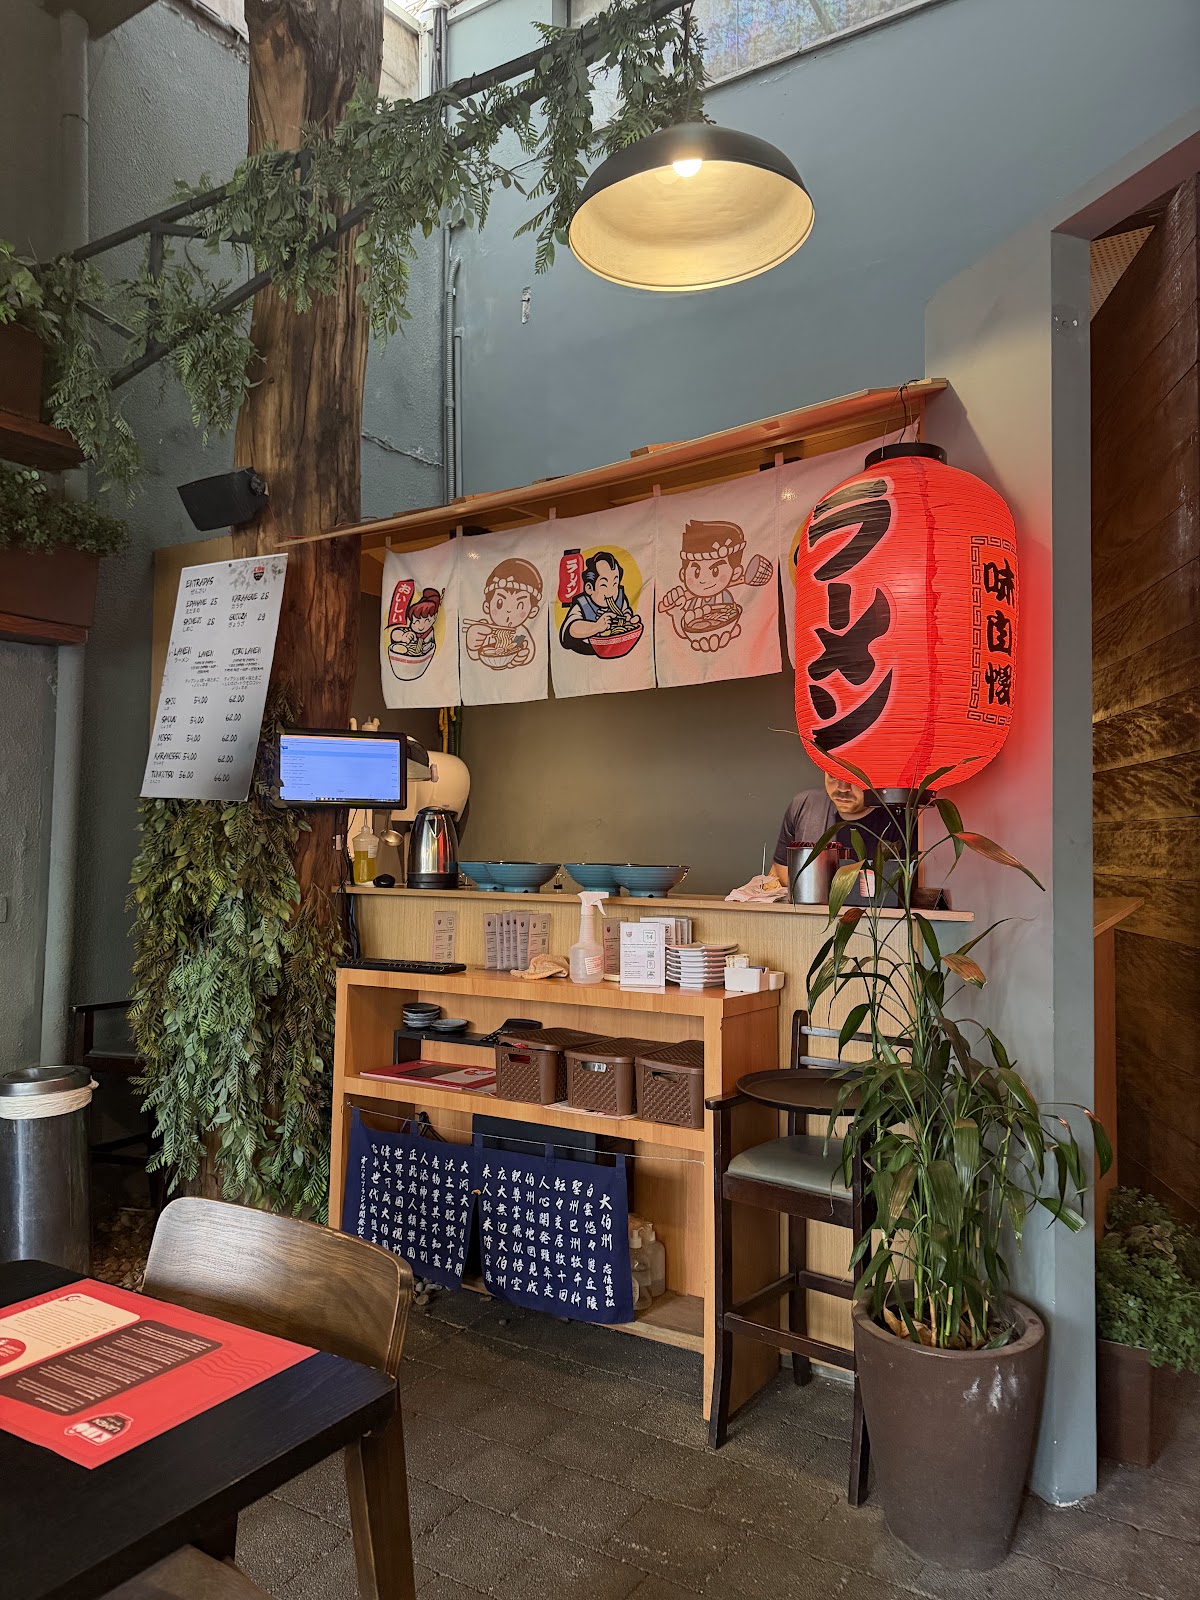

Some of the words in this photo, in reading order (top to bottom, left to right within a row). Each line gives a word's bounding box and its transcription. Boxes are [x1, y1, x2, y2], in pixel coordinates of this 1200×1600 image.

[565, 558, 579, 599] ラーメン
[392, 583, 411, 623] おいしい
[806, 477, 894, 752] ラーメン
[228, 695, 245, 703] 62.00
[225, 713, 242, 721] 62.00
[221, 734, 238, 742] 62.00
[217, 755, 234, 763] 62.00
[598, 1193, 613, 1251] 大伯州
